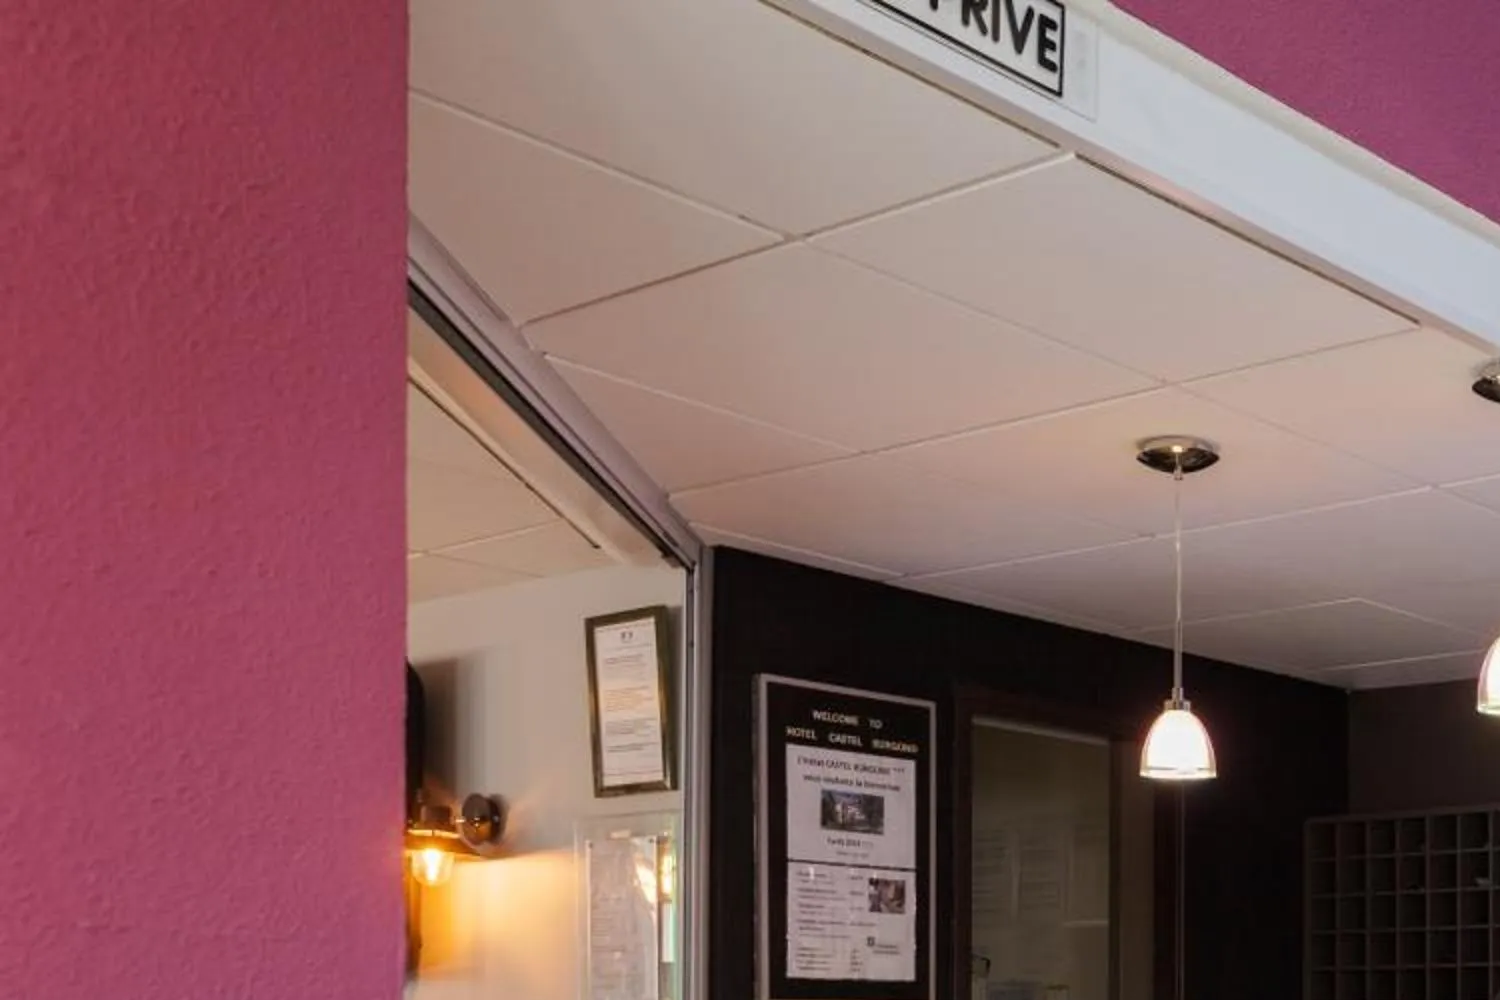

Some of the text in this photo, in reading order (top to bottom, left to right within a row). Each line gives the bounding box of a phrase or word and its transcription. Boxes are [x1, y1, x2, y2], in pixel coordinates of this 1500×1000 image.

[929, 0, 1058, 73] RIVE
[812, 710, 883, 729] WELCOME TO
[785, 726, 818, 741] HOTEL
[828, 733, 863, 746] CASTEL
